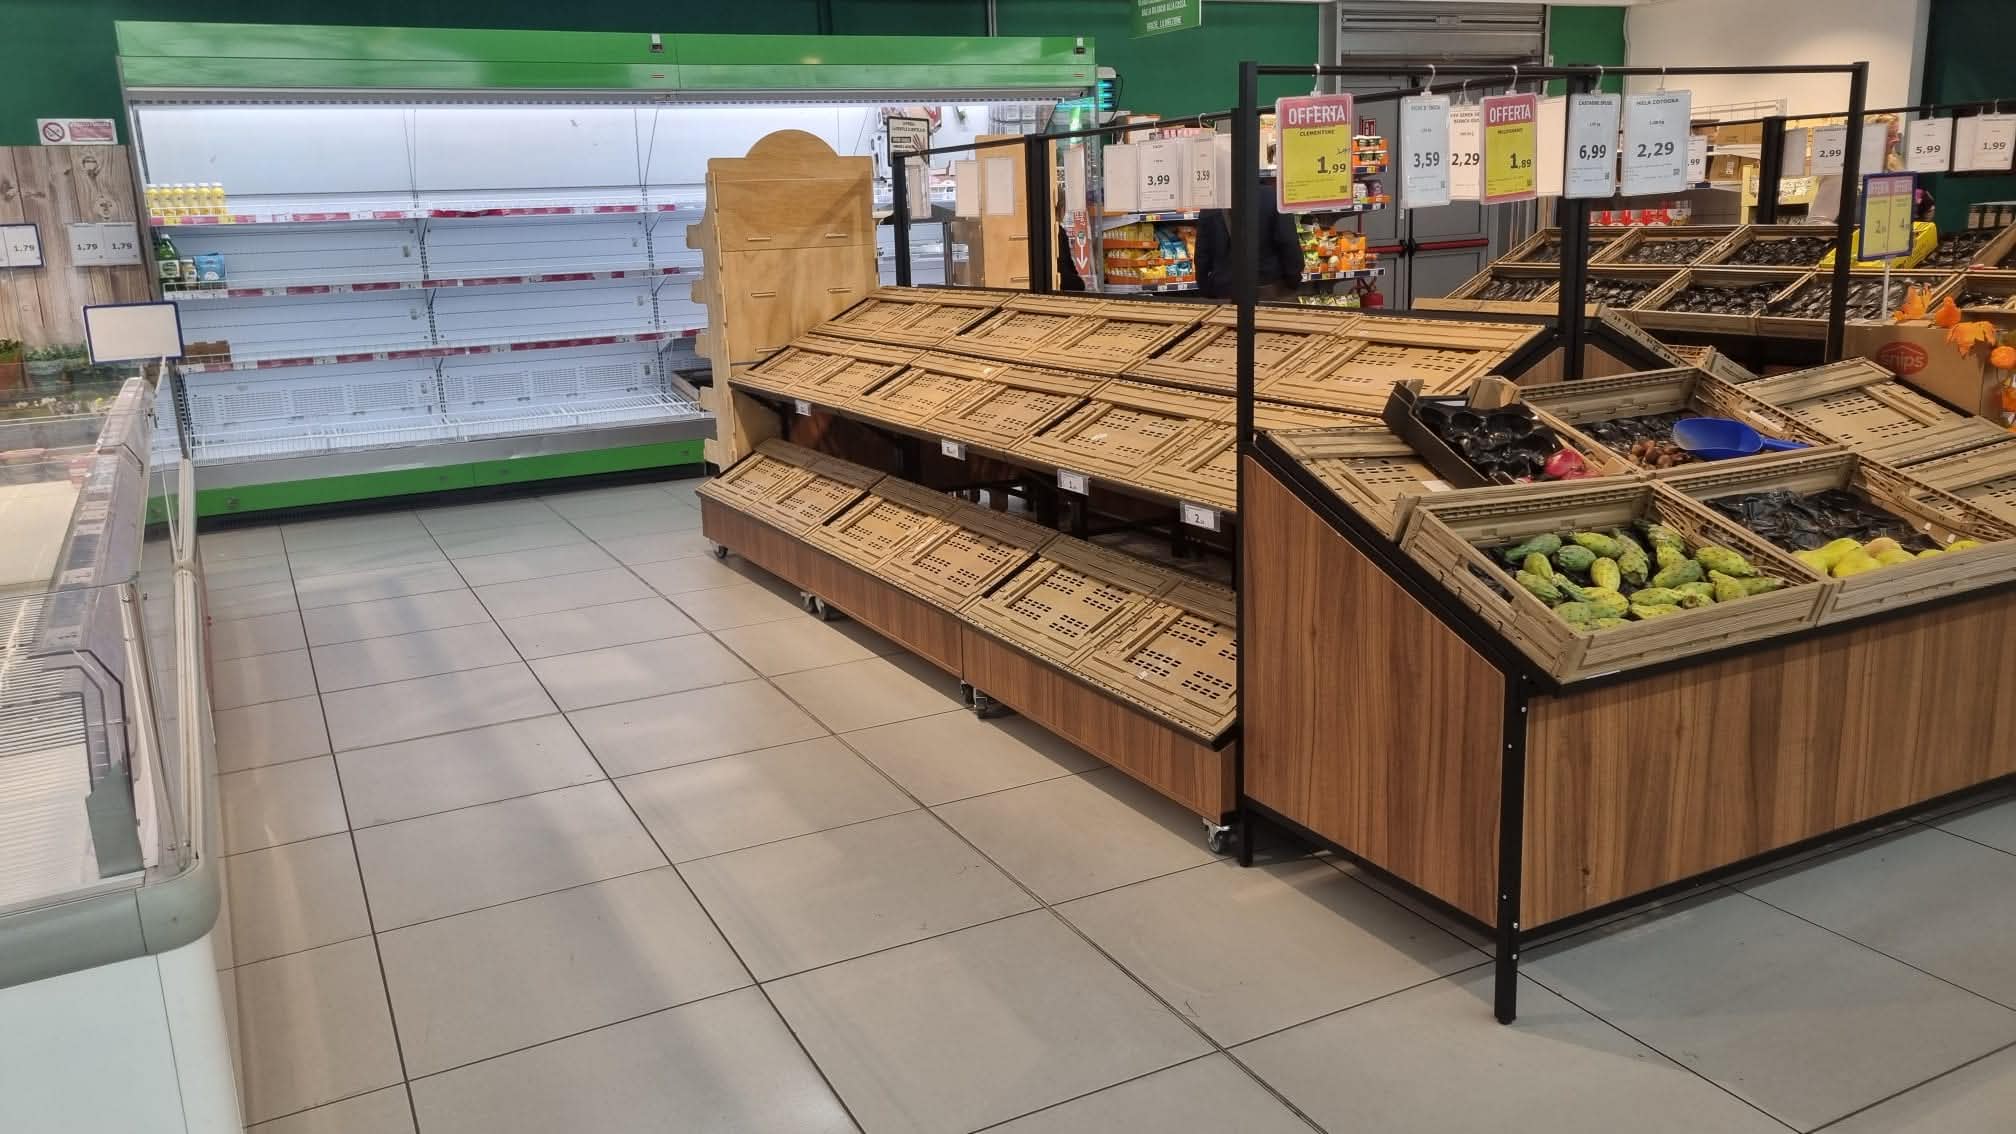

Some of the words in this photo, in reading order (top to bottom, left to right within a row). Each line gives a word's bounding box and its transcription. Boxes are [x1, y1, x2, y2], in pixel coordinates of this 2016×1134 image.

[1288, 104, 1346, 126] OFFERTA
[1488, 103, 1532, 123] OFFERTA
[1299, 129, 1335, 137] CLEMENTINE
[1578, 144, 1607, 161] 6,99
[1636, 141, 1675, 159] 2,29
[1316, 155, 1347, 175] 1,99
[1413, 152, 1441, 169] 3,59
[1451, 153, 1480, 167] 2,29
[1509, 153, 1532, 169] 1,89
[1147, 174, 1170, 187] 3,99
